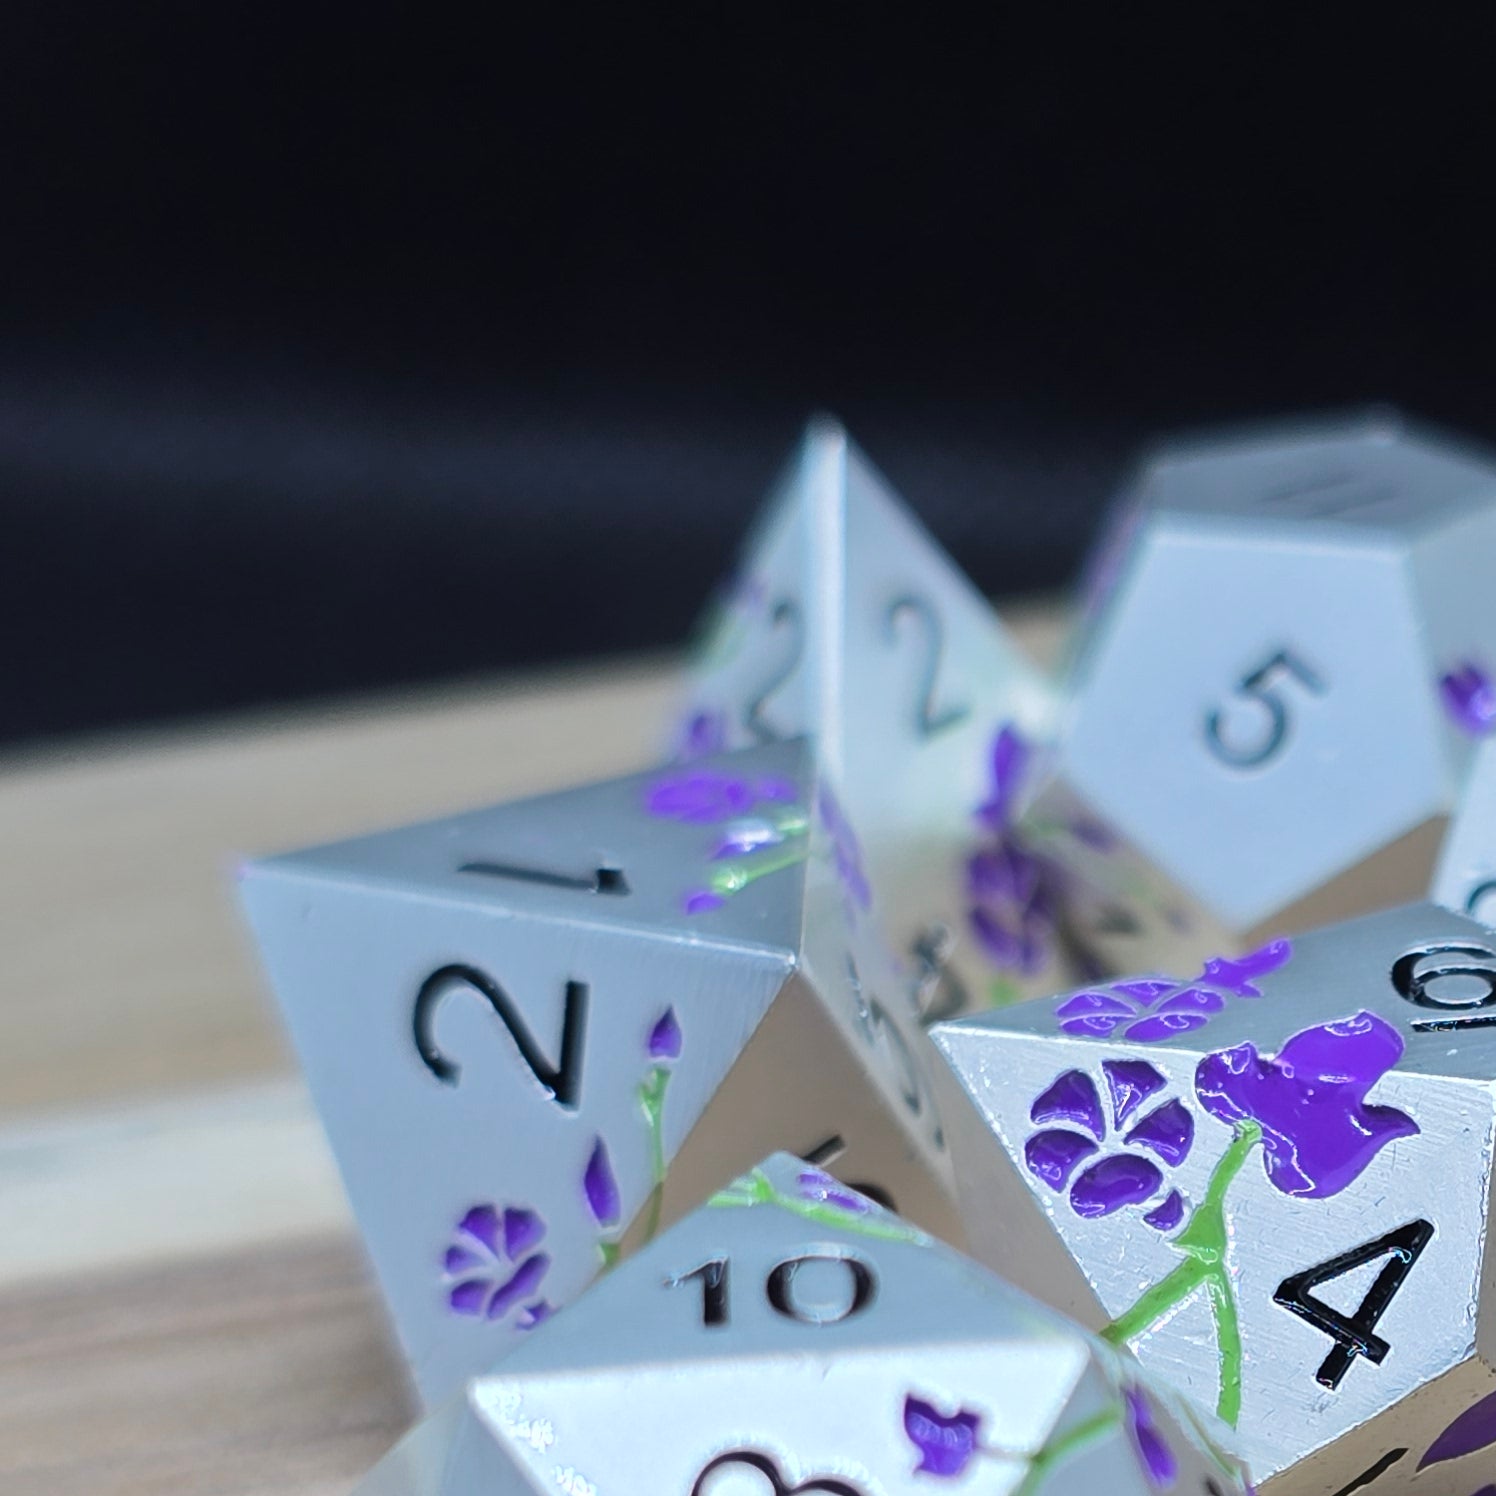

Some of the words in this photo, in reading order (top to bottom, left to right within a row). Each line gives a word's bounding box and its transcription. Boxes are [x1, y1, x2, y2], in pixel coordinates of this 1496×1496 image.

[878, 596, 972, 744] 2
[1206, 646, 1326, 772] 5
[457, 858, 632, 897] 1
[411, 962, 590, 1114] 2
[662, 1254, 880, 1328] 10
[1272, 1217, 1436, 1392] 4
